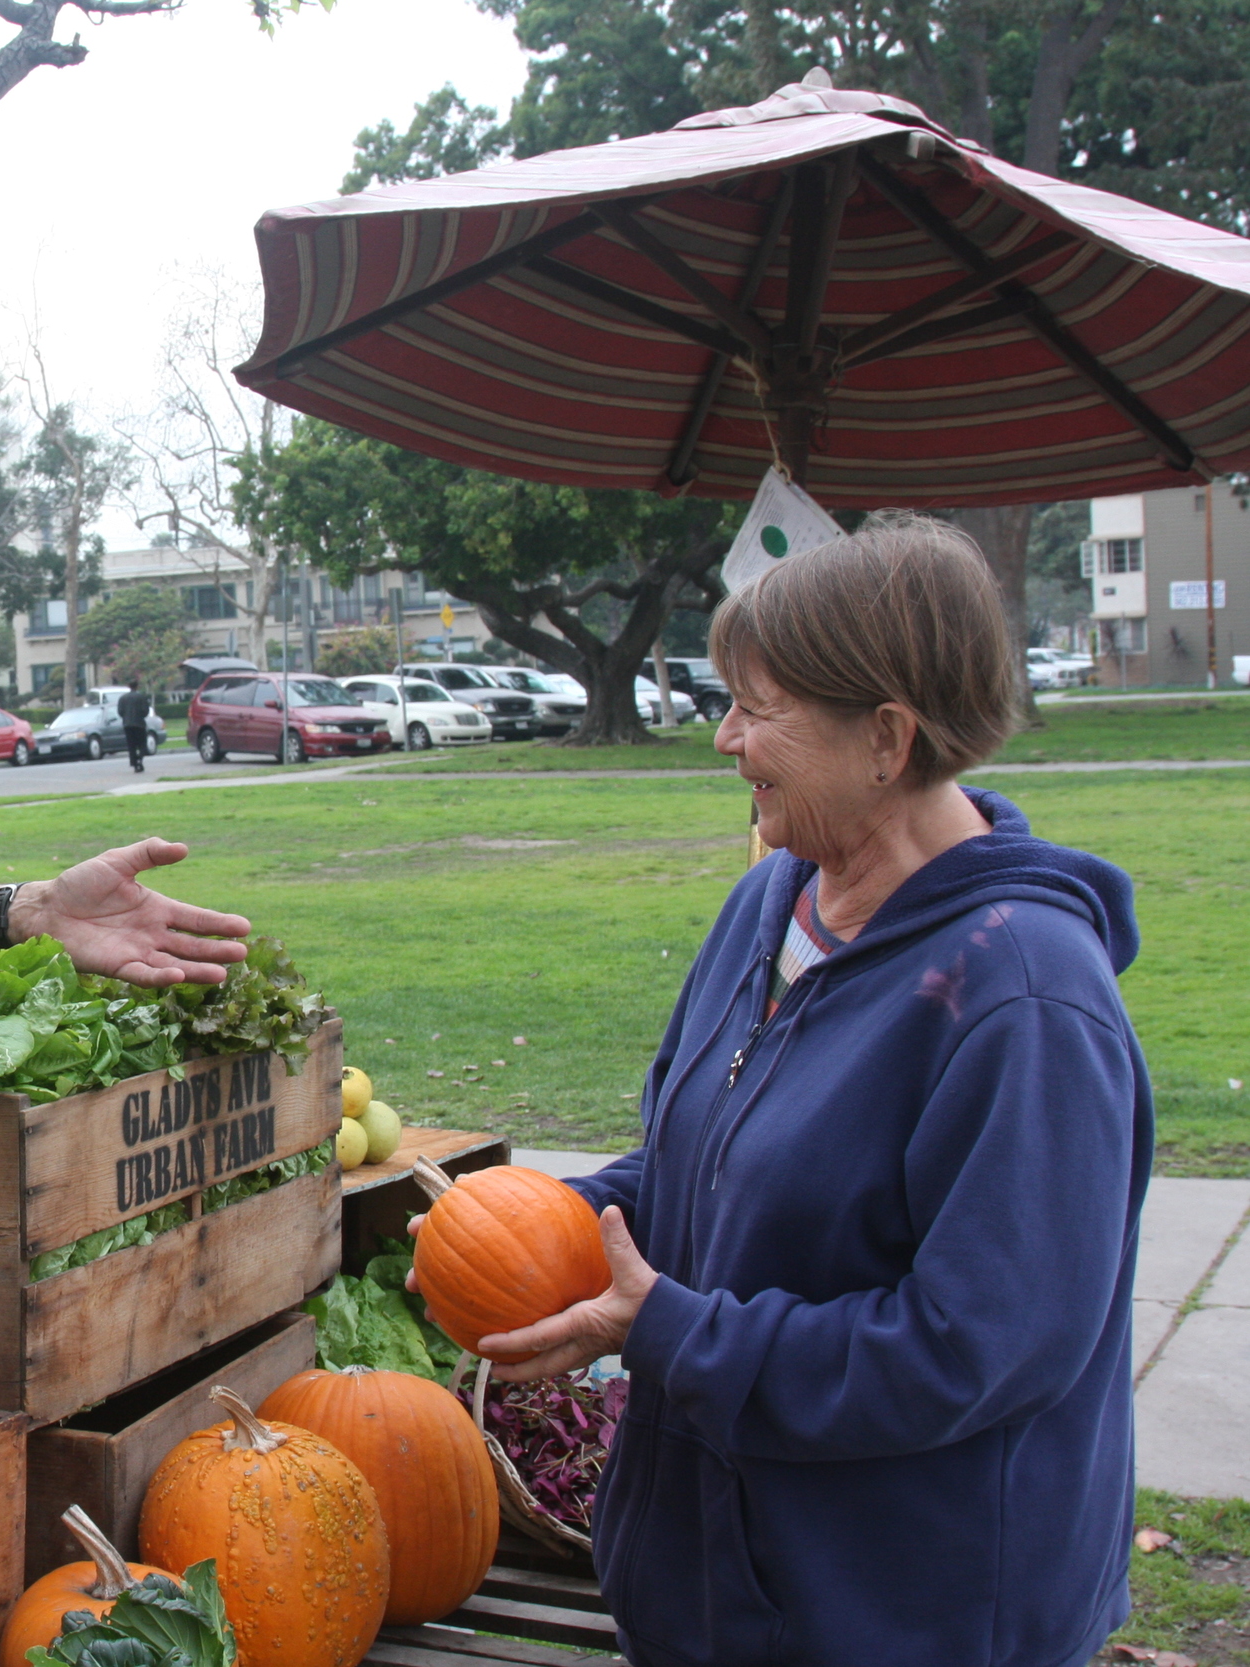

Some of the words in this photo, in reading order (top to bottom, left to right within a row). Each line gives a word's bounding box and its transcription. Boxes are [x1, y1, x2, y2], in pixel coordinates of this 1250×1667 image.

[122, 1068, 221, 1147] GLADYS
[229, 1053, 271, 1111] AVE
[117, 1130, 207, 1213] URBAN
[214, 1108, 275, 1176] FARM
